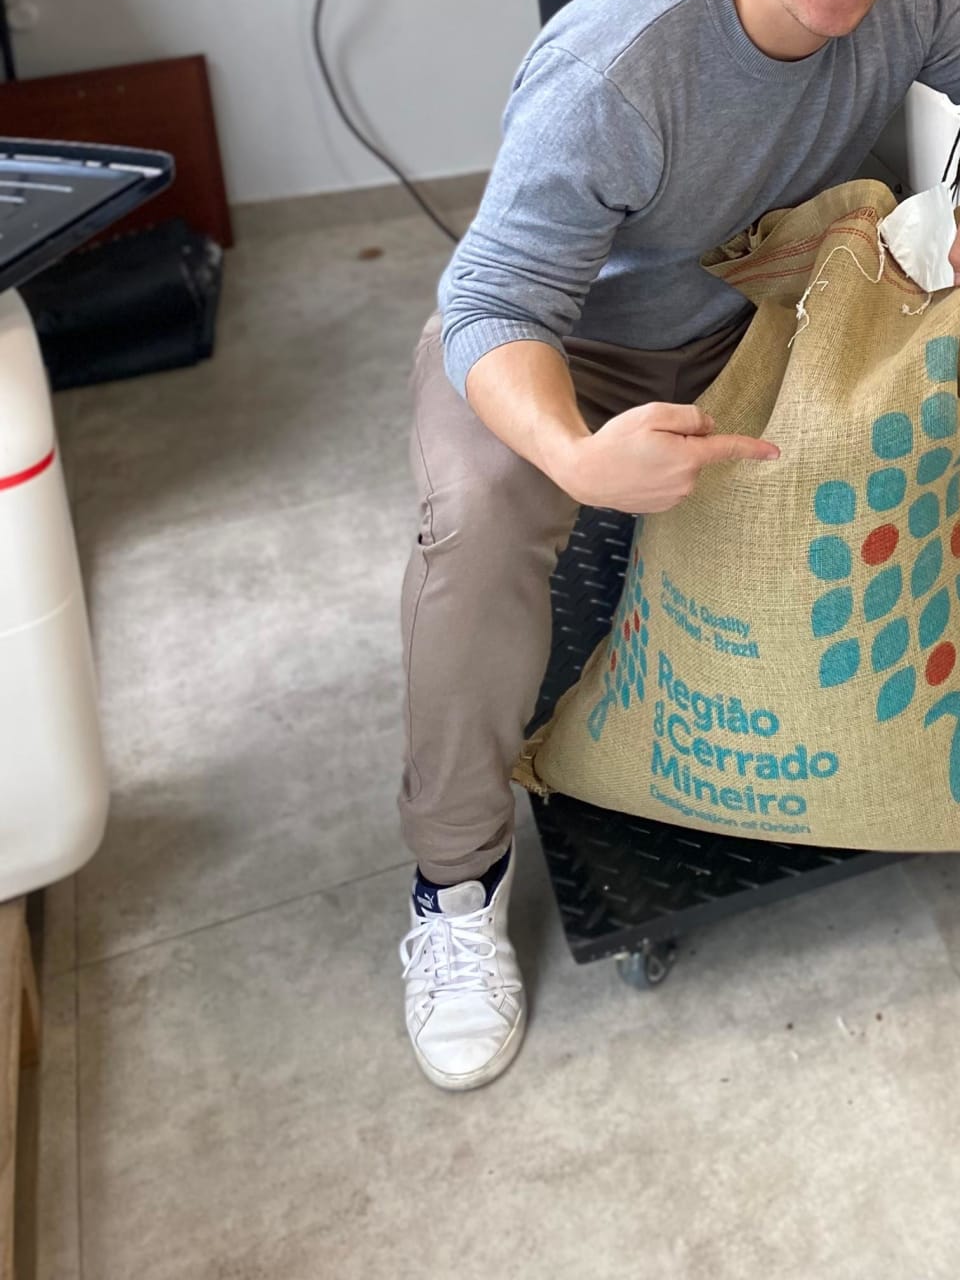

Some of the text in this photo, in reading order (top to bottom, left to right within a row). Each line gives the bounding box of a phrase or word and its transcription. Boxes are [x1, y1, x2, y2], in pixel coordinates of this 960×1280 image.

[658, 650, 780, 737] Região
[651, 739, 808, 817] Mineiro
[667, 713, 839, 781] Cerrado
